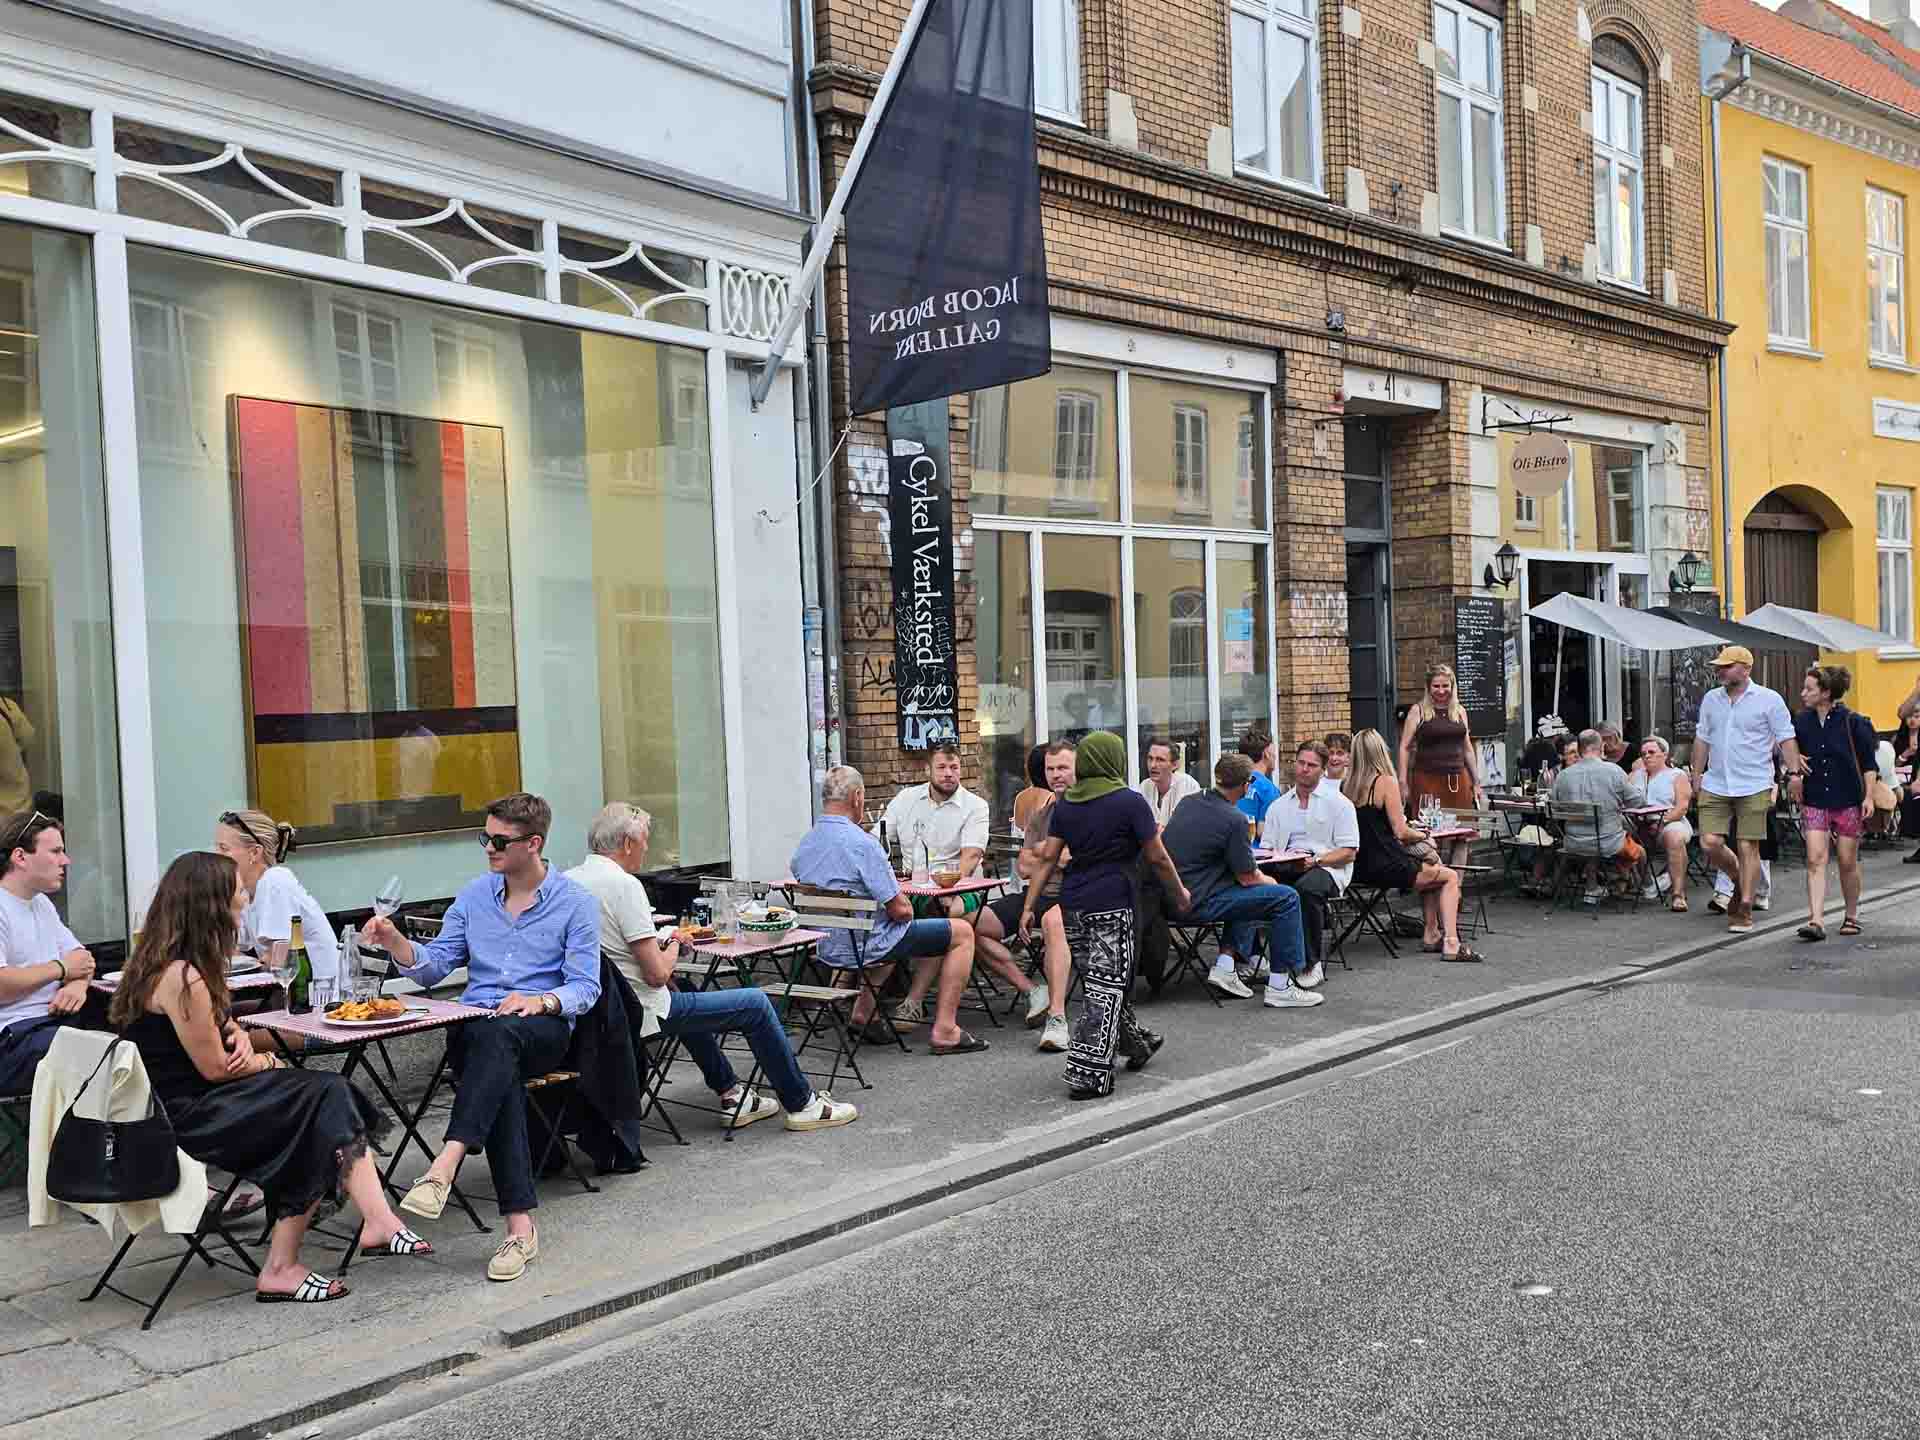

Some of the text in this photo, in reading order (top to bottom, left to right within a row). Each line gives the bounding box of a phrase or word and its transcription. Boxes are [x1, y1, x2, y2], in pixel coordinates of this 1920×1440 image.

[1384, 373, 1396, 401] 41
[901, 455, 940, 536] Cykel
[912, 536, 945, 666] Værksted
